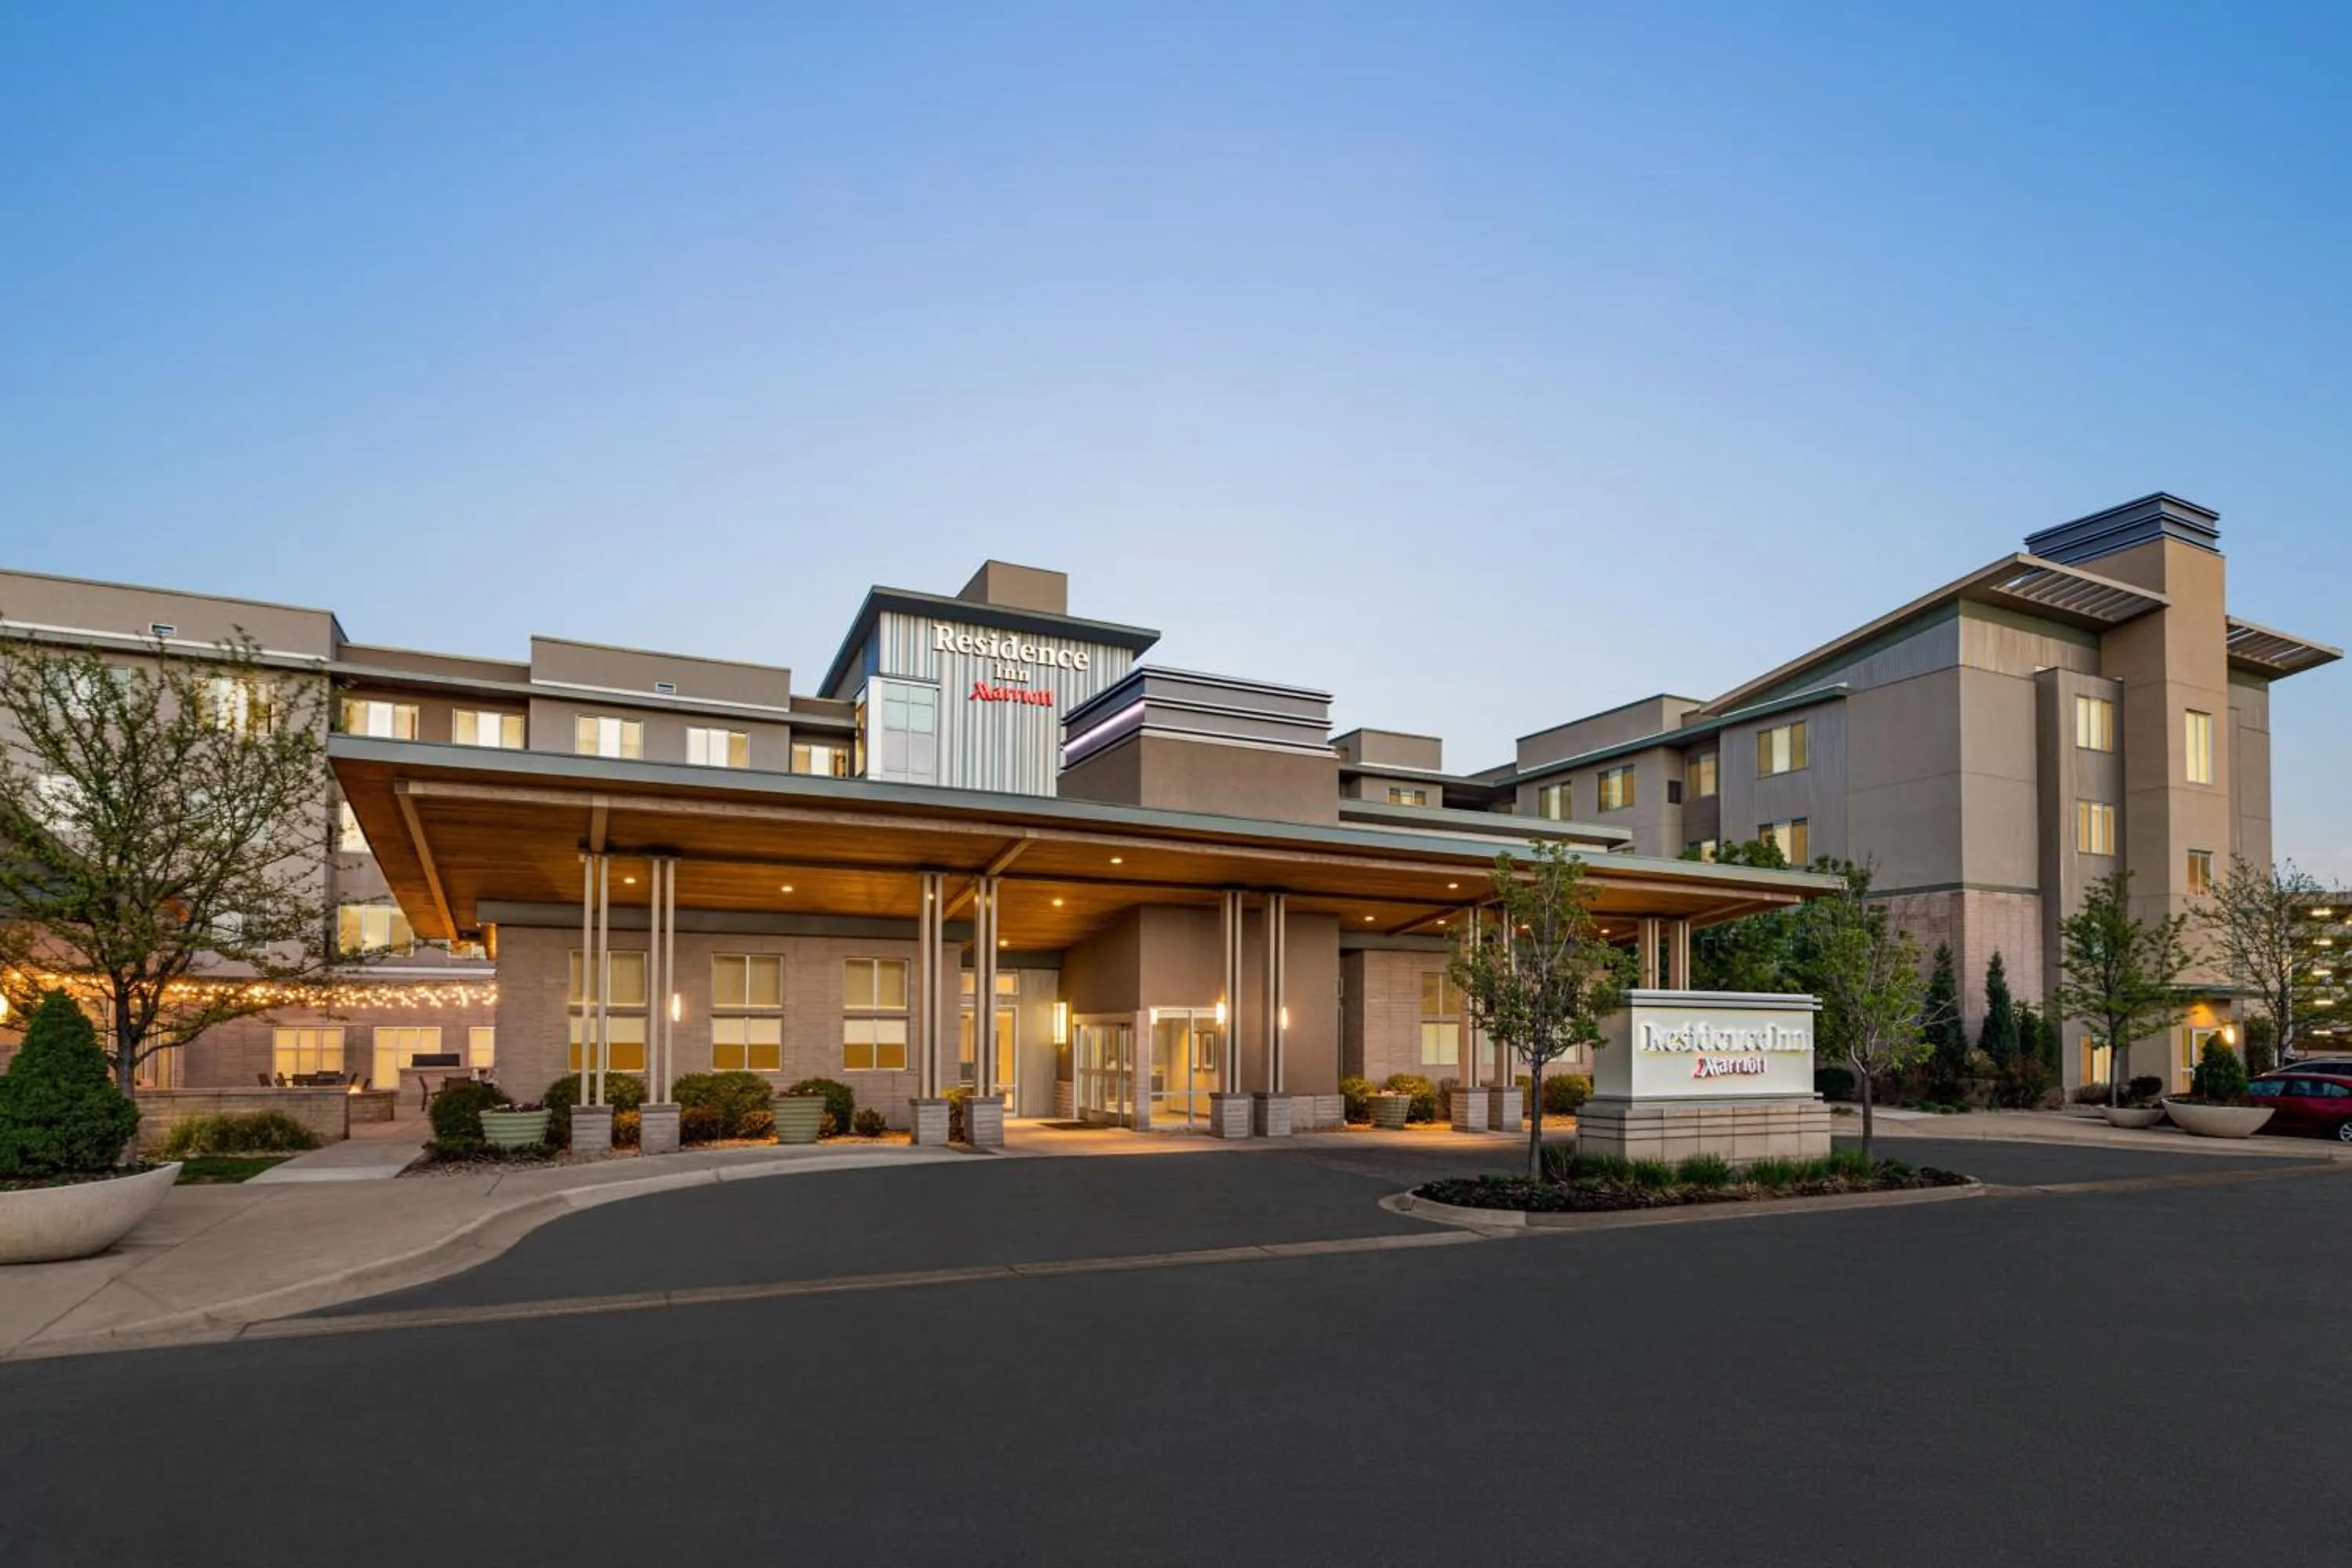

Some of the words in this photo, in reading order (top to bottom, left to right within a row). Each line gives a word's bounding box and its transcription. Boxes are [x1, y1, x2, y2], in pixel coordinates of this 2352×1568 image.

[933, 625, 1089, 670] Residence
[993, 662, 1030, 682] Inn
[969, 681, 1054, 707] Marriott
